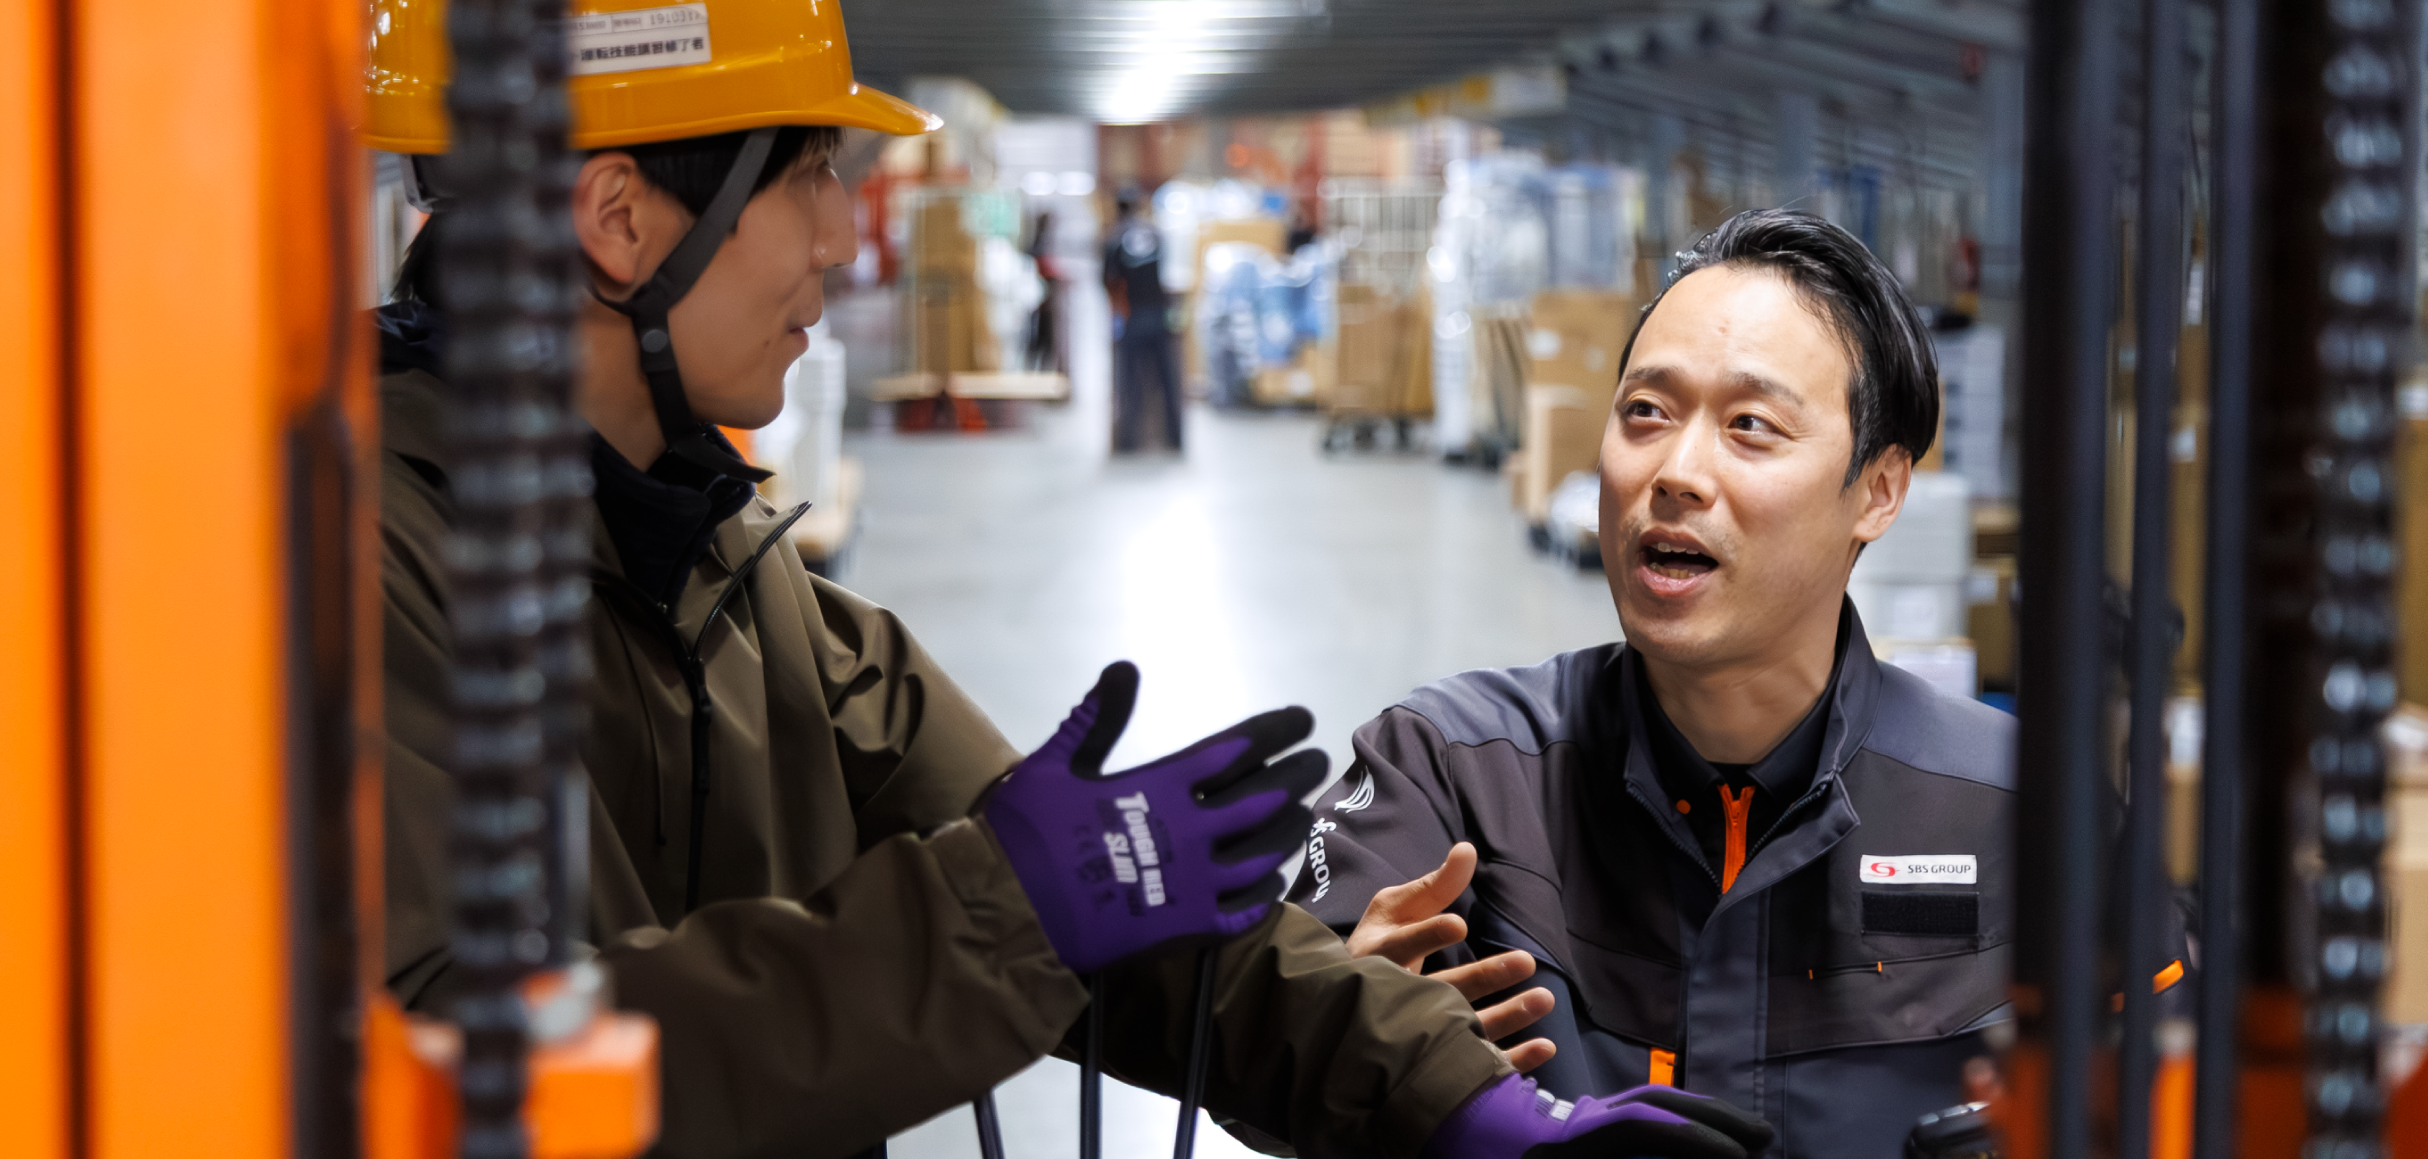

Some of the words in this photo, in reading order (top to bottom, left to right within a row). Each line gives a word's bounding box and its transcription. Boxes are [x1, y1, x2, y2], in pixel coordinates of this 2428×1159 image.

[575, 37, 704, 61] 運転技能講習修了者
[1102, 832, 1138, 884] SLIM
[1907, 864, 1929, 874] SBS
[1930, 864, 1972, 874] GROUP
